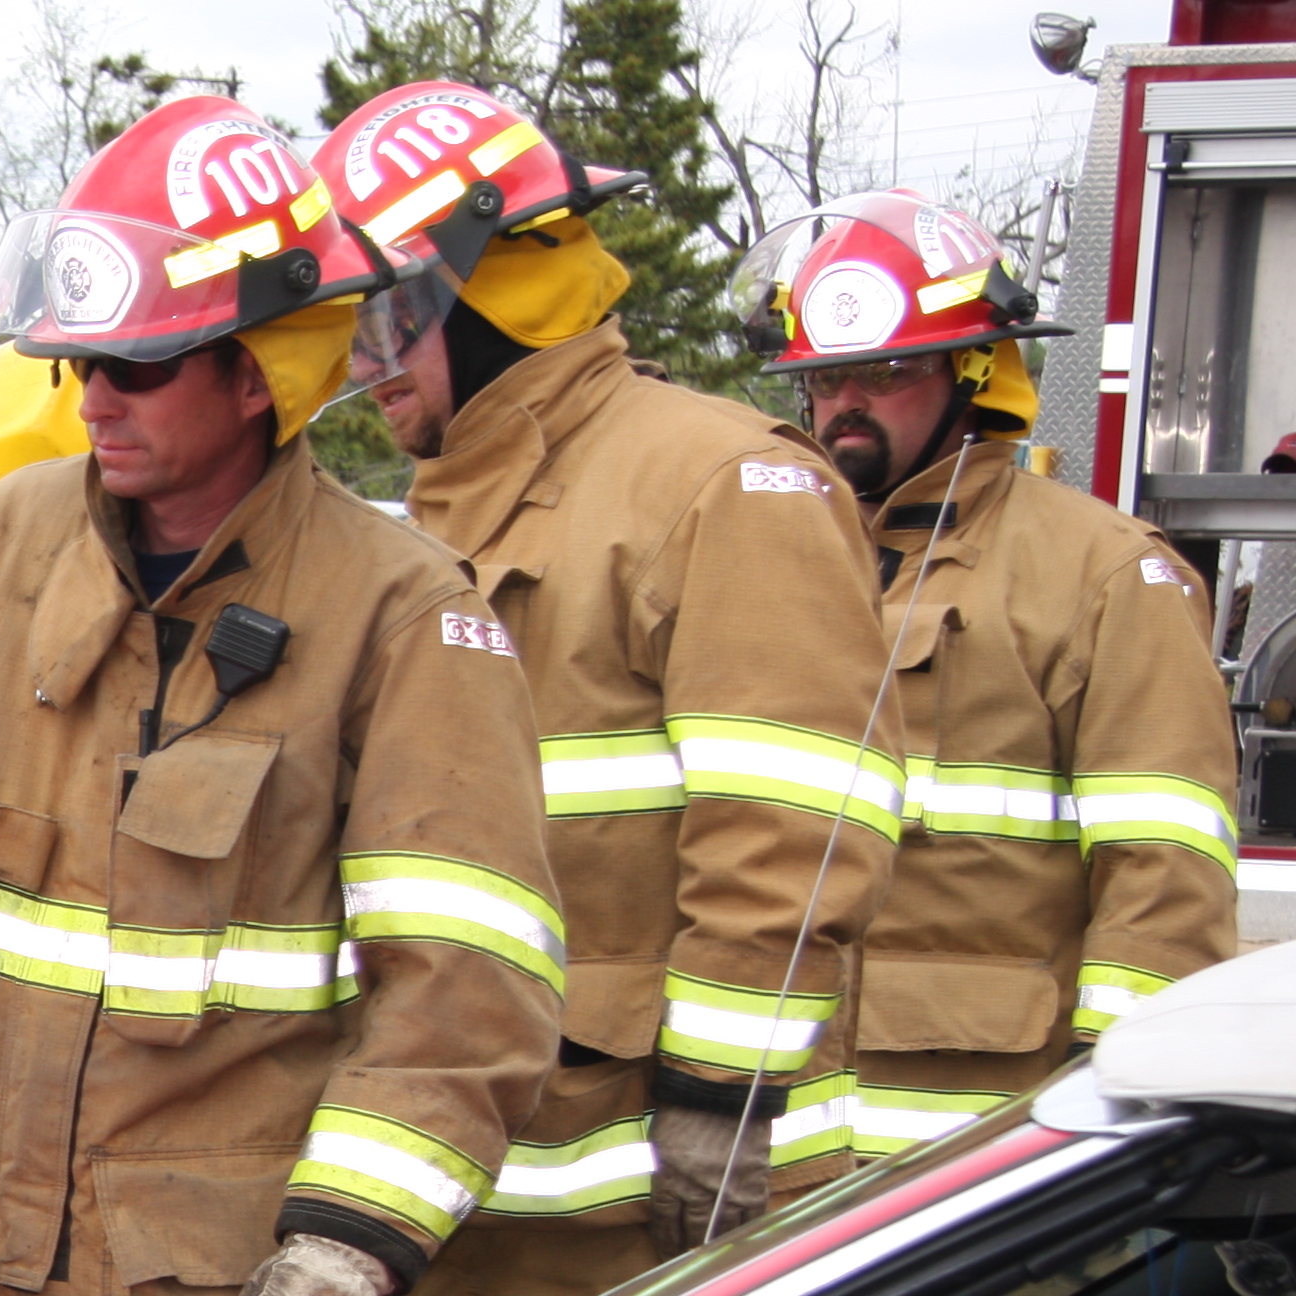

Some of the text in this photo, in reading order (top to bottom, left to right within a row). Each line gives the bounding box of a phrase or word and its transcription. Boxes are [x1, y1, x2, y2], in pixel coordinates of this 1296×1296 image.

[350, 95, 470, 176] FIREFIGHTER
[377, 108, 470, 179] 118
[204, 140, 299, 218] 107
